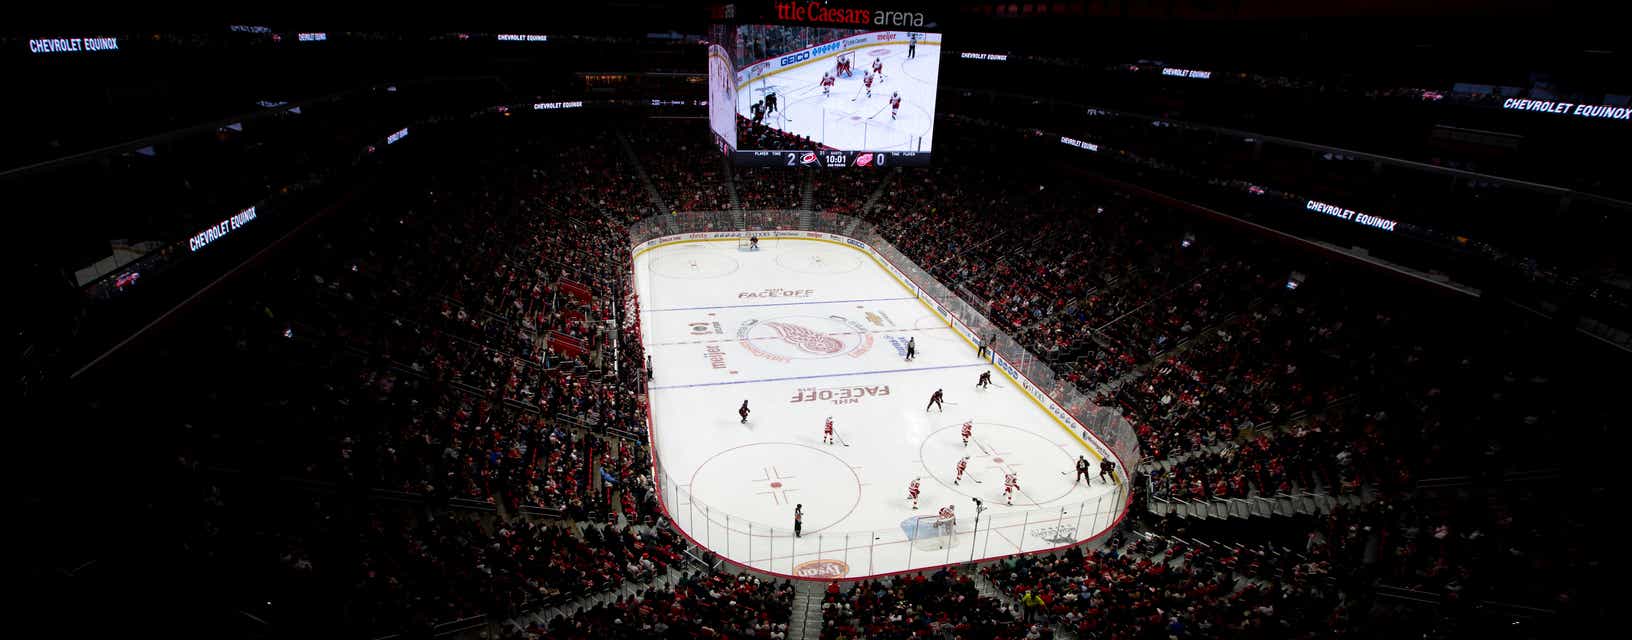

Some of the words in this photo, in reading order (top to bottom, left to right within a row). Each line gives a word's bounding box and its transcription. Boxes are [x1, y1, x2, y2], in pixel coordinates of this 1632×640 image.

[777, 2, 805, 20] ttle
[807, 1, 870, 25] Caesars
[873, 10, 924, 27] arena
[29, 38, 81, 53] CHEVROLET
[84, 37, 118, 51] EQUINOX
[781, 51, 810, 66] GEICO
[1504, 98, 1573, 114] CHEVROLET
[1574, 104, 1632, 120] EQUINOX
[787, 153, 796, 165] 2
[826, 155, 846, 164] 10:01
[876, 153, 885, 166] 0
[1306, 200, 1355, 221] CHEVROLET
[1355, 212, 1397, 232] EQUINOX
[189, 219, 230, 252] CHEVROLET
[230, 206, 257, 230] EQUINOX
[789, 385, 890, 404] FACE-OFF
